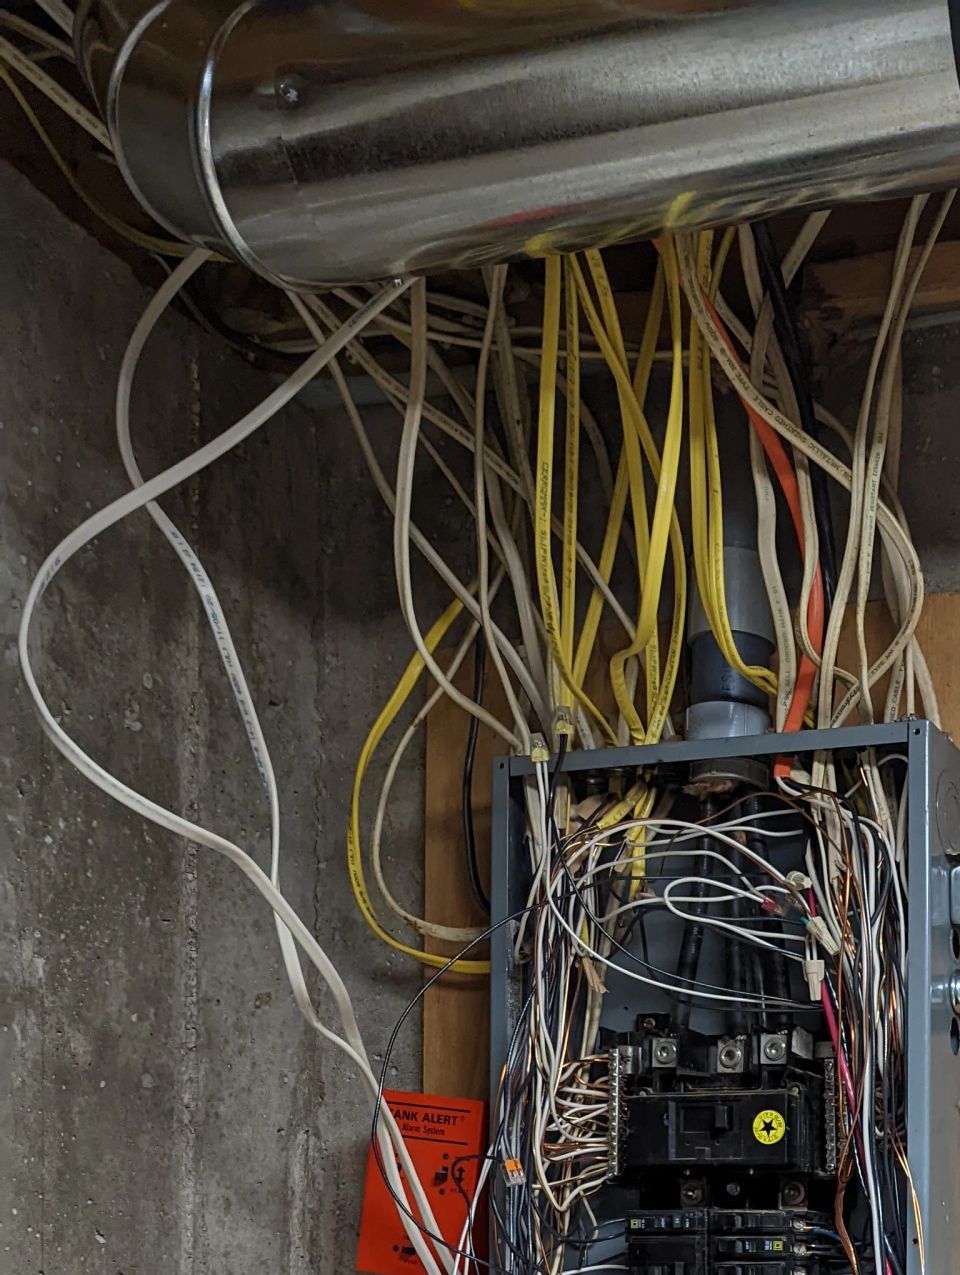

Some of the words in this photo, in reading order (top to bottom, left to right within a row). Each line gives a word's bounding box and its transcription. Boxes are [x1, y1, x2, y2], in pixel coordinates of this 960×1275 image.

[422, 1113, 459, 1126] ALERT
[402, 1123, 421, 1134] Alarm
[422, 1125, 445, 1136] System
